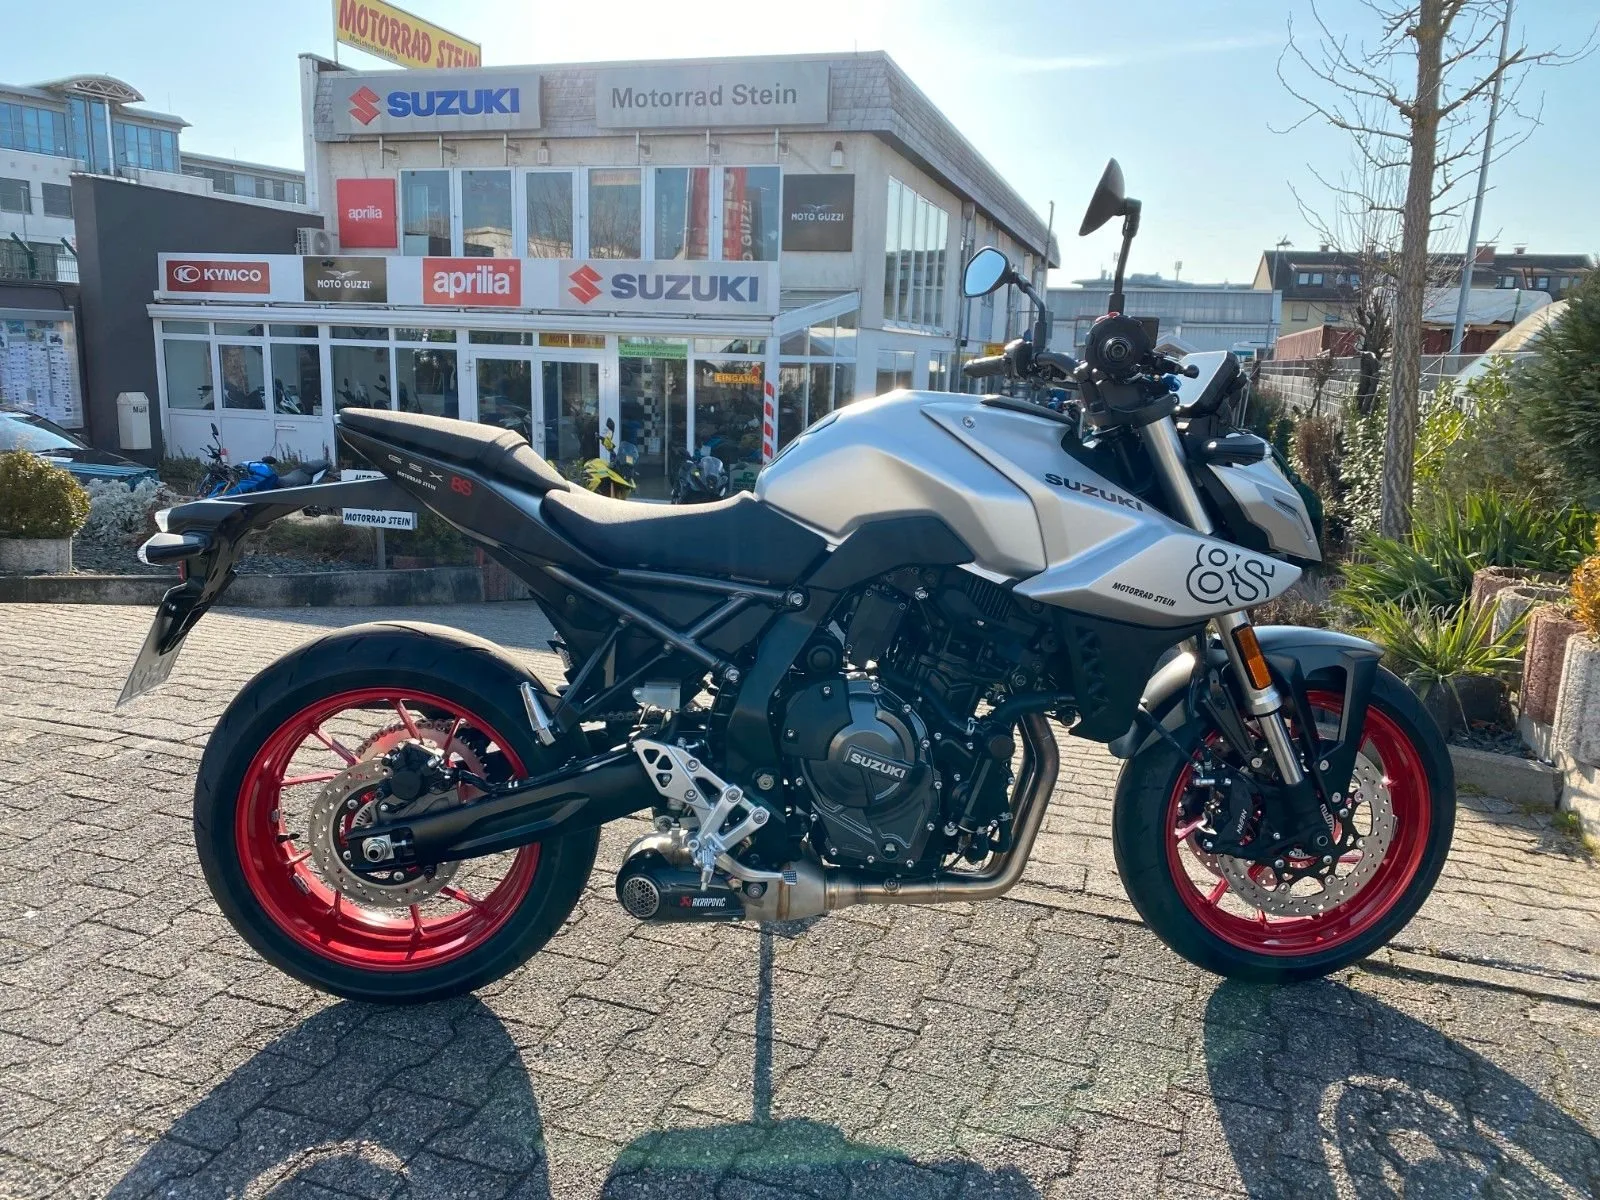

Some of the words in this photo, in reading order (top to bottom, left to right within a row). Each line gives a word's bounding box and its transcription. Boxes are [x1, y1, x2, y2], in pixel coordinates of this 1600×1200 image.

[338, 0, 432, 64] MOTORRAD
[436, 40, 478, 68] STEIN
[387, 88, 519, 118] SUZUKI
[612, 85, 723, 109] Motorrad
[731, 83, 797, 106] Stein
[348, 205, 382, 221] aprilia
[791, 213, 815, 221] MOTO
[818, 212, 844, 221] GUZZI
[203, 268, 262, 283] KYMCO
[317, 279, 341, 289] MOTO
[344, 280, 371, 289] GUZZI
[432, 264, 511, 299] aprilia
[611, 273, 758, 303] SUZUKI
[716, 373, 759, 383] EINGANG
[396, 470, 422, 485] MOTORRAD
[422, 481, 437, 491] STEIN
[1045, 472, 1144, 512] SUZUKI
[344, 512, 386, 525] MOTORRAD
[388, 516, 411, 527] STEIN
[1112, 581, 1154, 600] MOTORRAD
[1153, 594, 1177, 607] STEIN
[850, 752, 906, 779] SUZUKI
